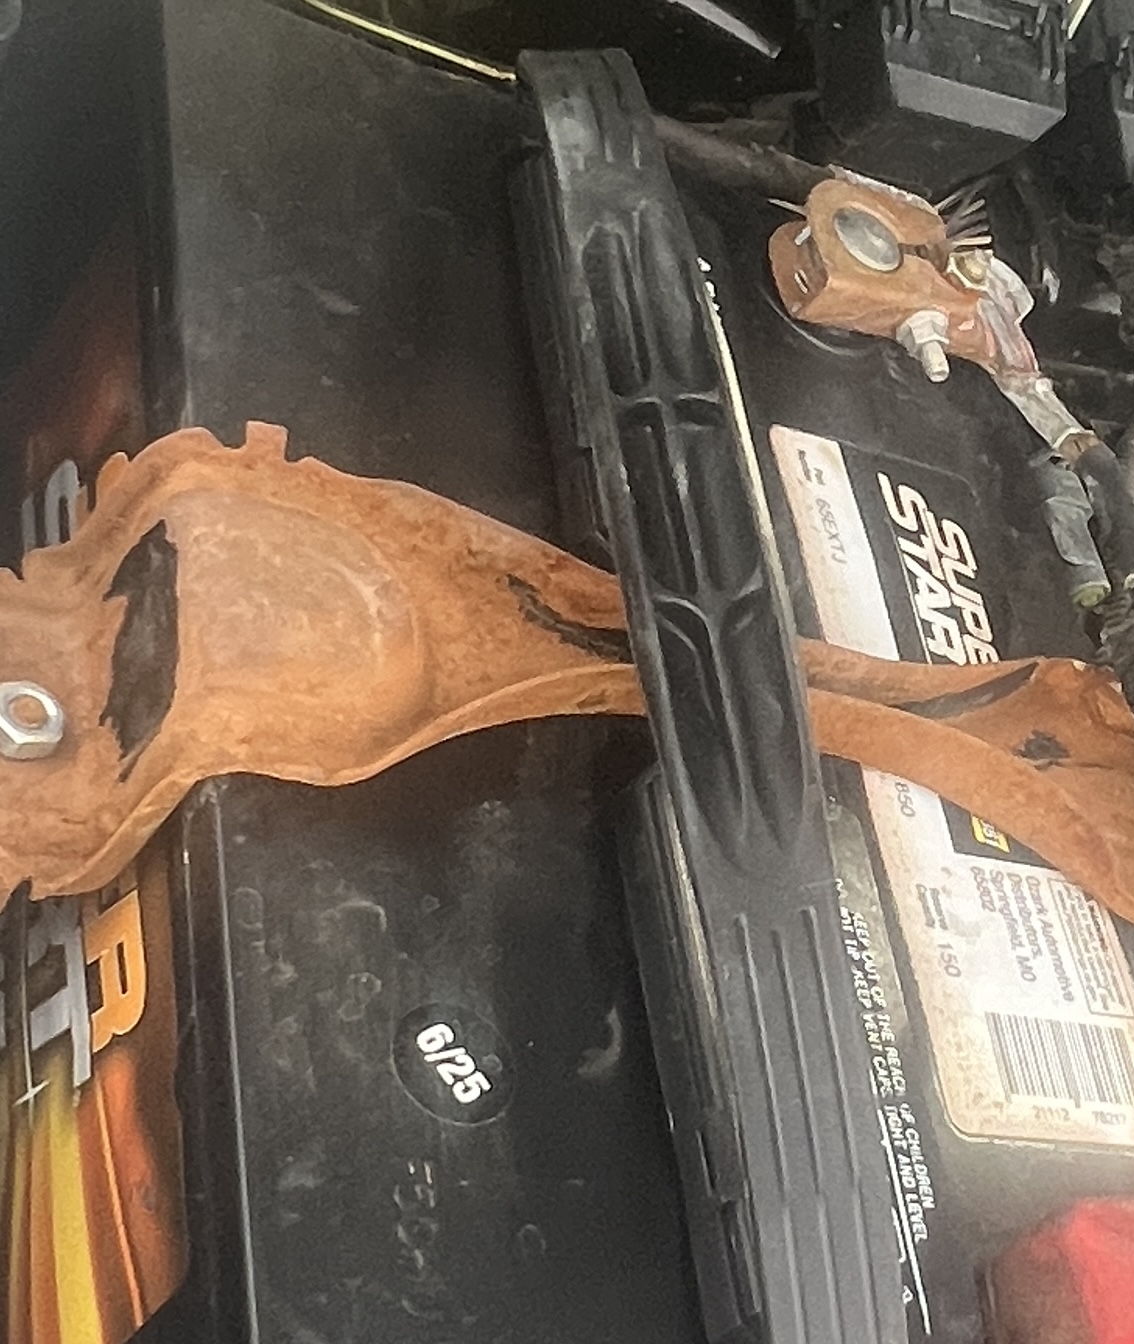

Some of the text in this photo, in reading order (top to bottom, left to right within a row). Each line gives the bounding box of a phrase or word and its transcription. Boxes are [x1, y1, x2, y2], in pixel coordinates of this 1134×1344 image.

[816, 498, 848, 564] 65EXTJ
[877, 471, 967, 666] STAR
[924, 509, 1000, 665] SUPE
[894, 781, 916, 817] 850
[970, 865, 996, 912] 65802
[937, 942, 962, 978] 150
[1025, 875, 1075, 1002] Ozark Automotive
[861, 951, 881, 983] OUT
[1015, 955, 1037, 982] MO
[871, 986, 887, 1008] OF
[862, 1014, 883, 1052] VENT
[877, 1014, 896, 1042] THE
[416, 1023, 493, 1104] 6/25
[884, 1105, 908, 1150] TIGHT
[897, 1153, 916, 1189] AND
[905, 1127, 935, 1209] CHILDREN
[905, 1193, 928, 1244] LEVEL
